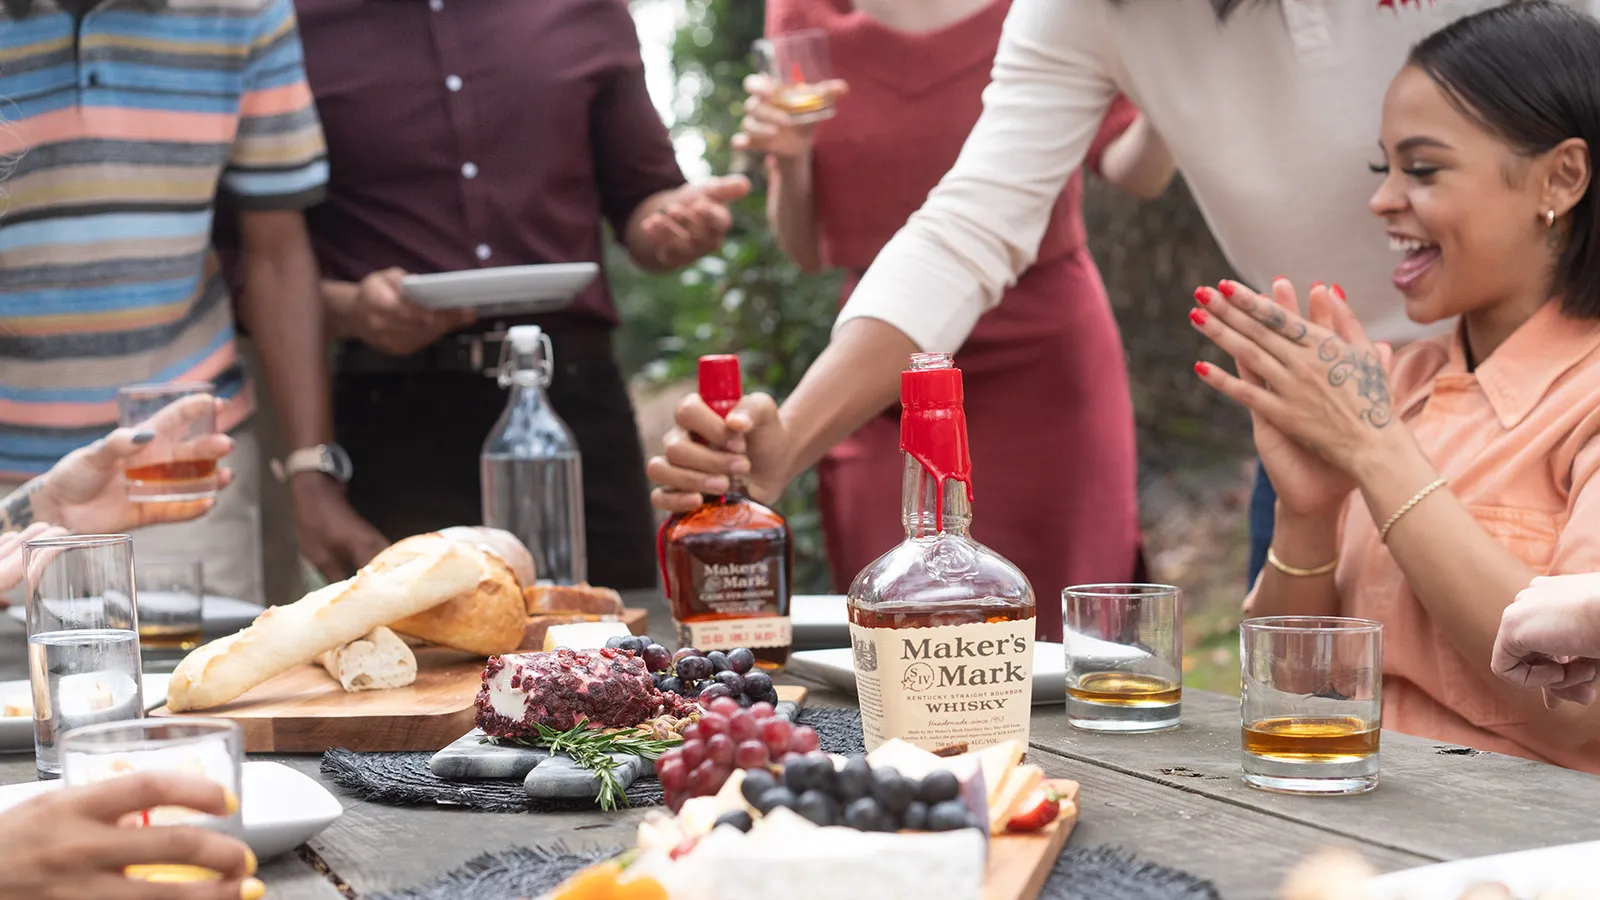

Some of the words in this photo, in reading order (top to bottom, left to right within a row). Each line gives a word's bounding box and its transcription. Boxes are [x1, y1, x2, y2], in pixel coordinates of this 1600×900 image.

[900, 633, 1026, 660] Maker's
[936, 661, 1026, 688] Mark
[990, 689, 1023, 697] BOURBON
[925, 698, 1008, 713] WHISKY
[928, 719, 968, 727] Handmade
